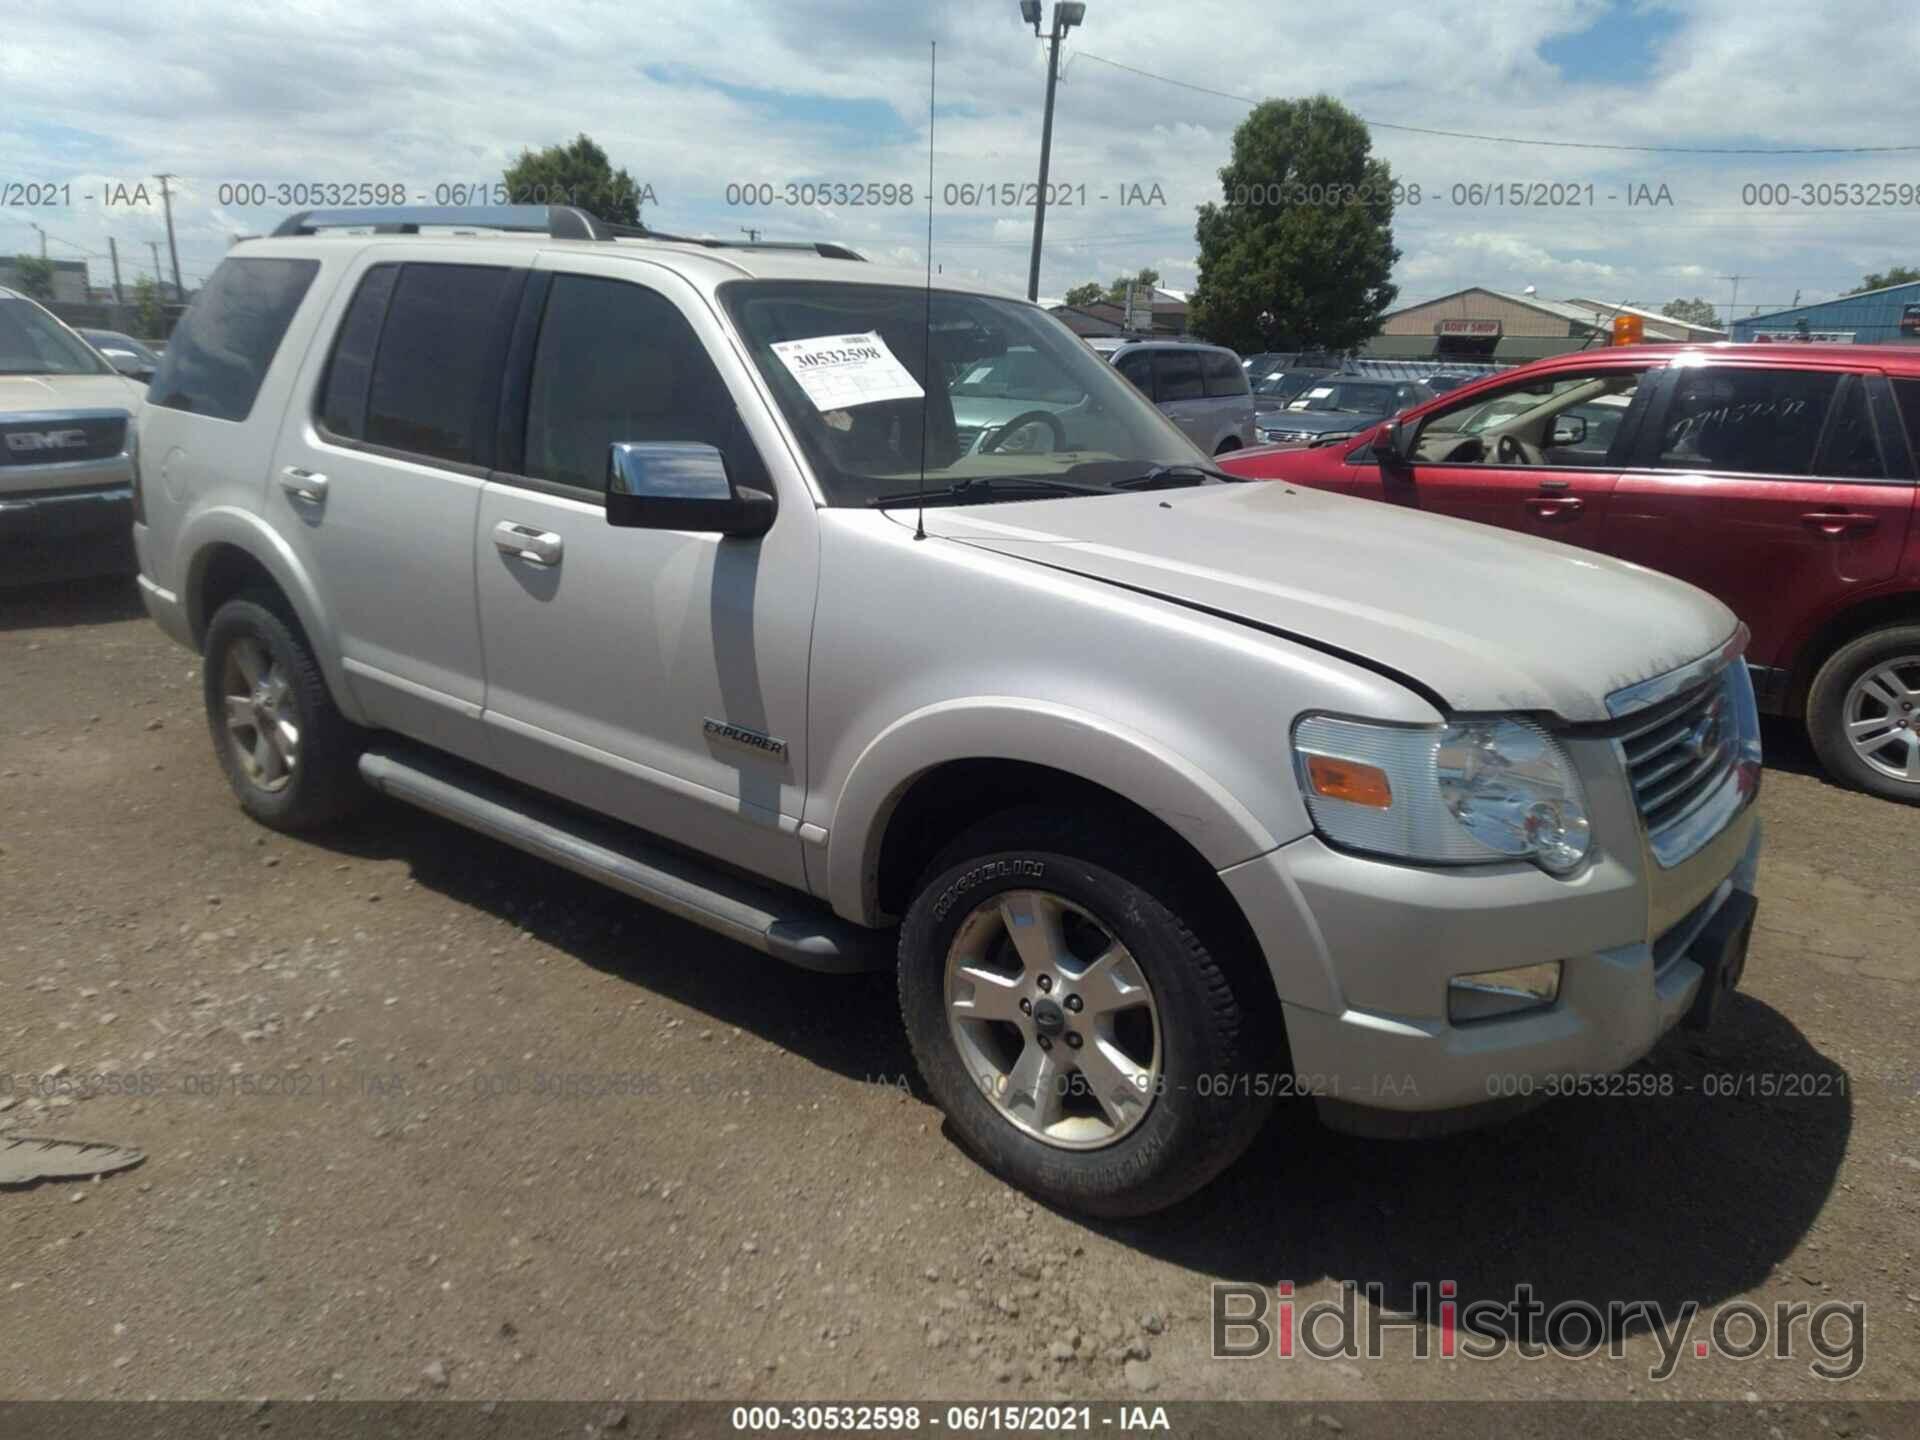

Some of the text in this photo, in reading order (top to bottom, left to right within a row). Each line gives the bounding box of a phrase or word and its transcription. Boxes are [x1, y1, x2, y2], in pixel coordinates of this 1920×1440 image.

[1444, 322, 1497, 332] BODY SHOP
[793, 347, 881, 368] 30532598
[5, 428, 88, 451] GMC
[704, 721, 782, 753] EXPLORER
